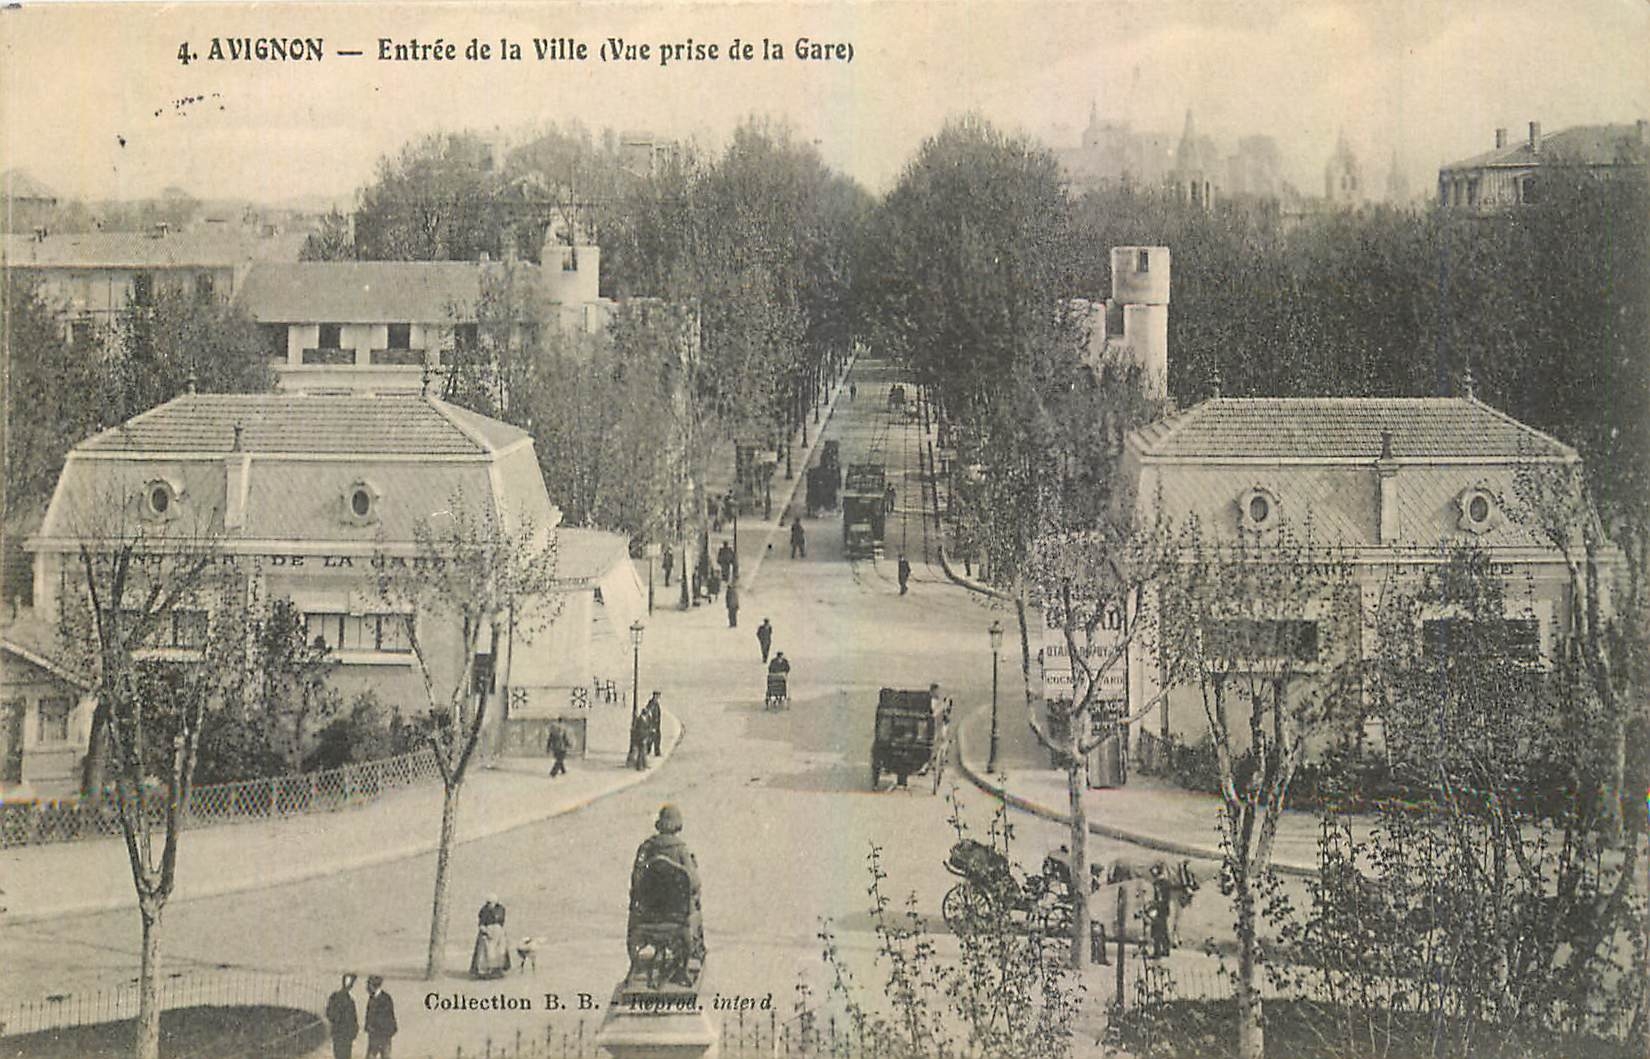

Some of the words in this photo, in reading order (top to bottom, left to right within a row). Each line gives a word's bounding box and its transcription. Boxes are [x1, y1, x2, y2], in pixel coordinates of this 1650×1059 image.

[79, 554, 162, 565] GRND
[271, 555, 305, 567] DE
[323, 556, 353, 568] LA
